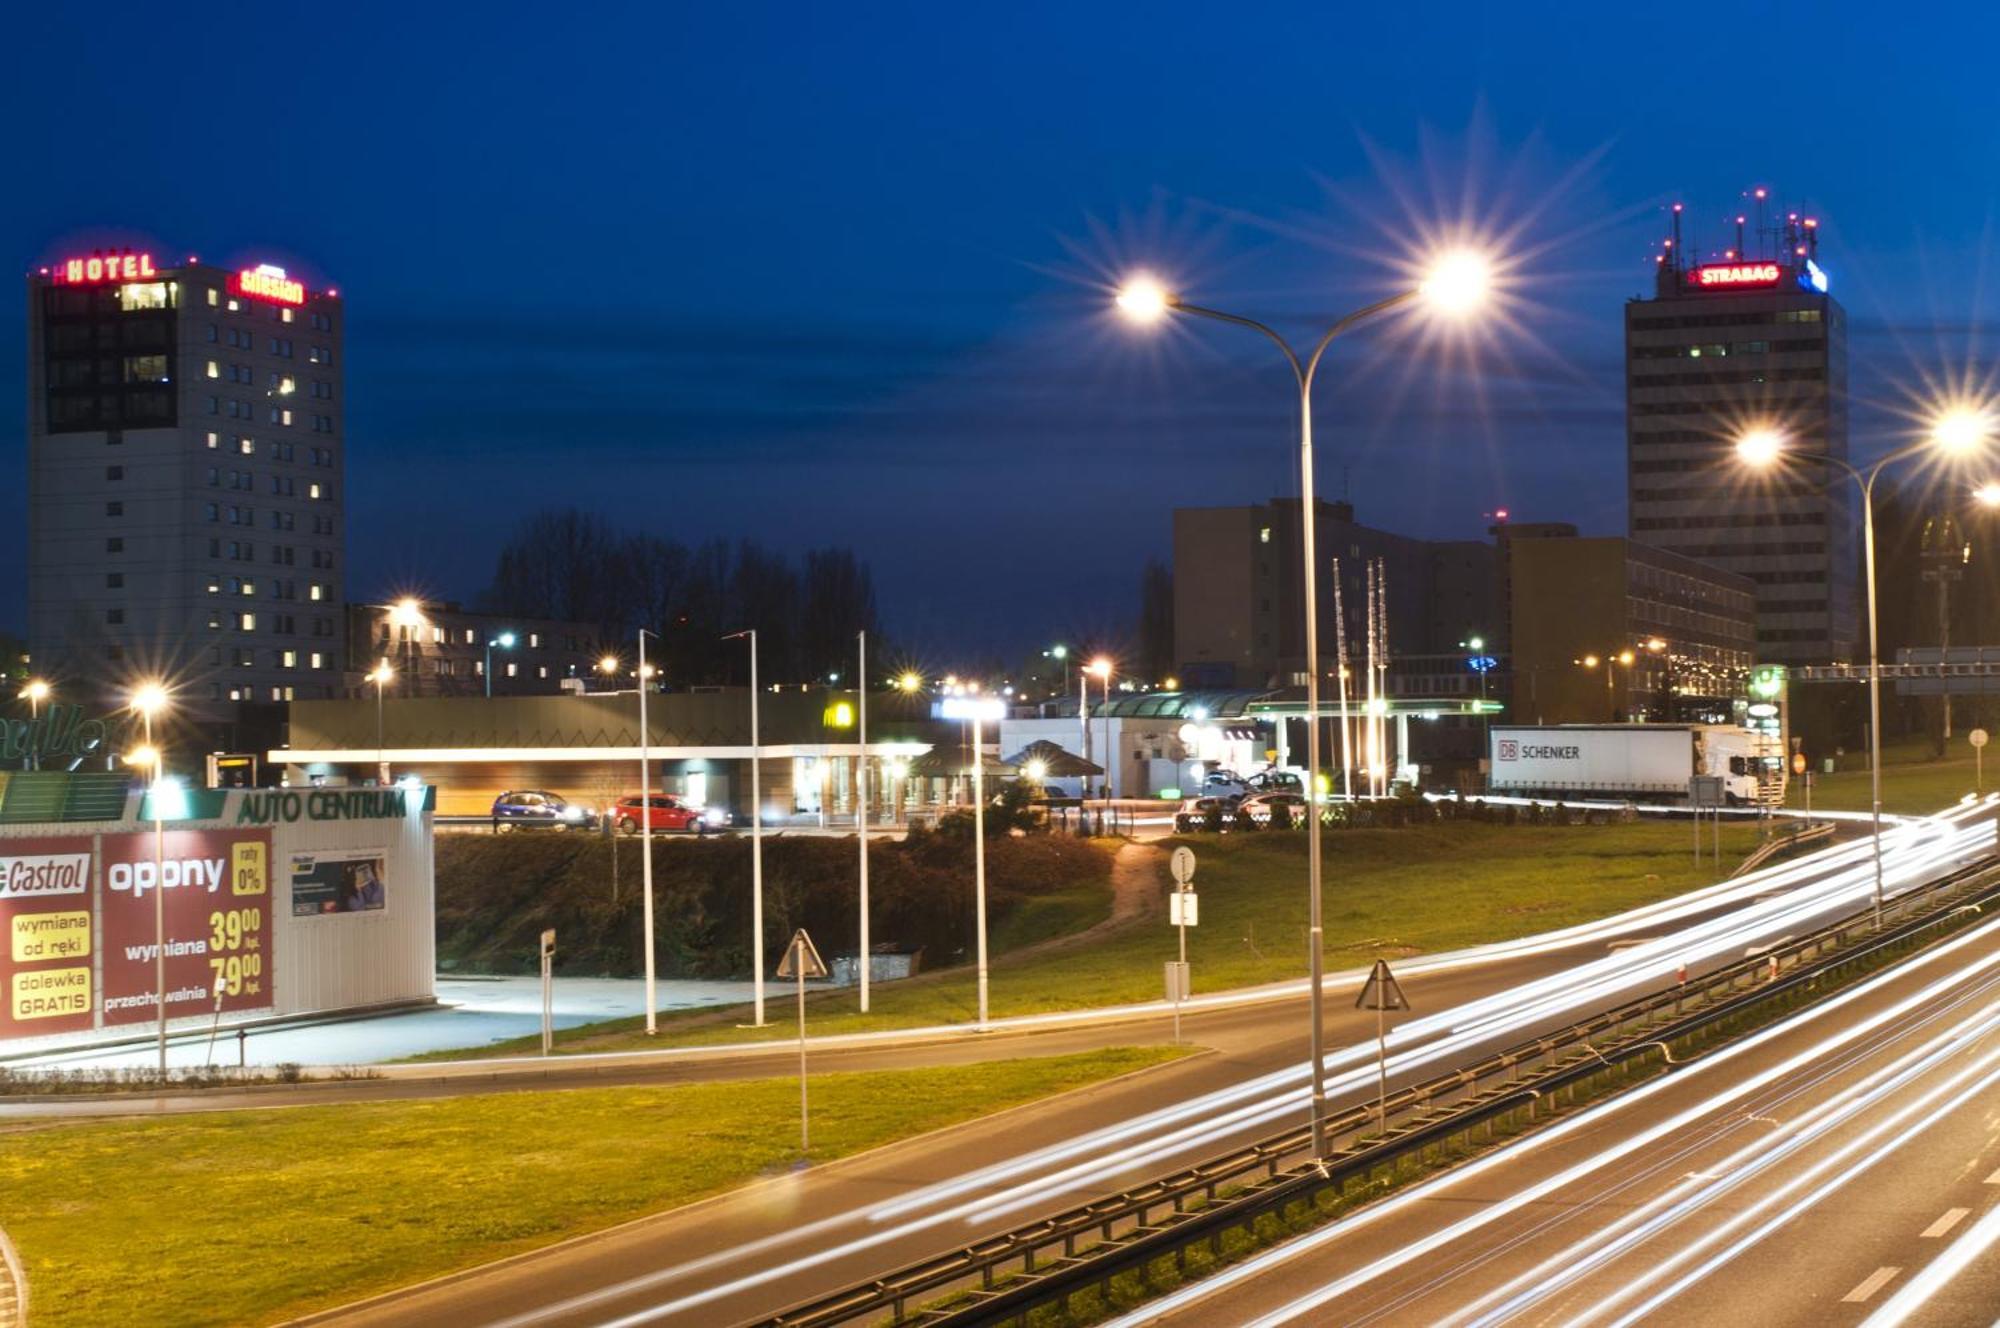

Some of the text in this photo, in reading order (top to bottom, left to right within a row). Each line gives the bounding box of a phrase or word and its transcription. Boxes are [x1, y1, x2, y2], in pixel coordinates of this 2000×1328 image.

[67, 254, 155, 282] HOTEL
[1701, 266, 1779, 284] STRABAG
[1500, 742, 1579, 759] DB SCHENKER
[237, 788, 406, 823] AUTO CENTRUM
[9, 859, 82, 893] Castrol
[109, 858, 225, 897] opony
[238, 868, 261, 890] 0%
[17, 914, 87, 934] wymiana
[24, 937, 81, 957] od ręki
[18, 973, 86, 991] dolewka
[18, 994, 86, 1015] GRATIS
